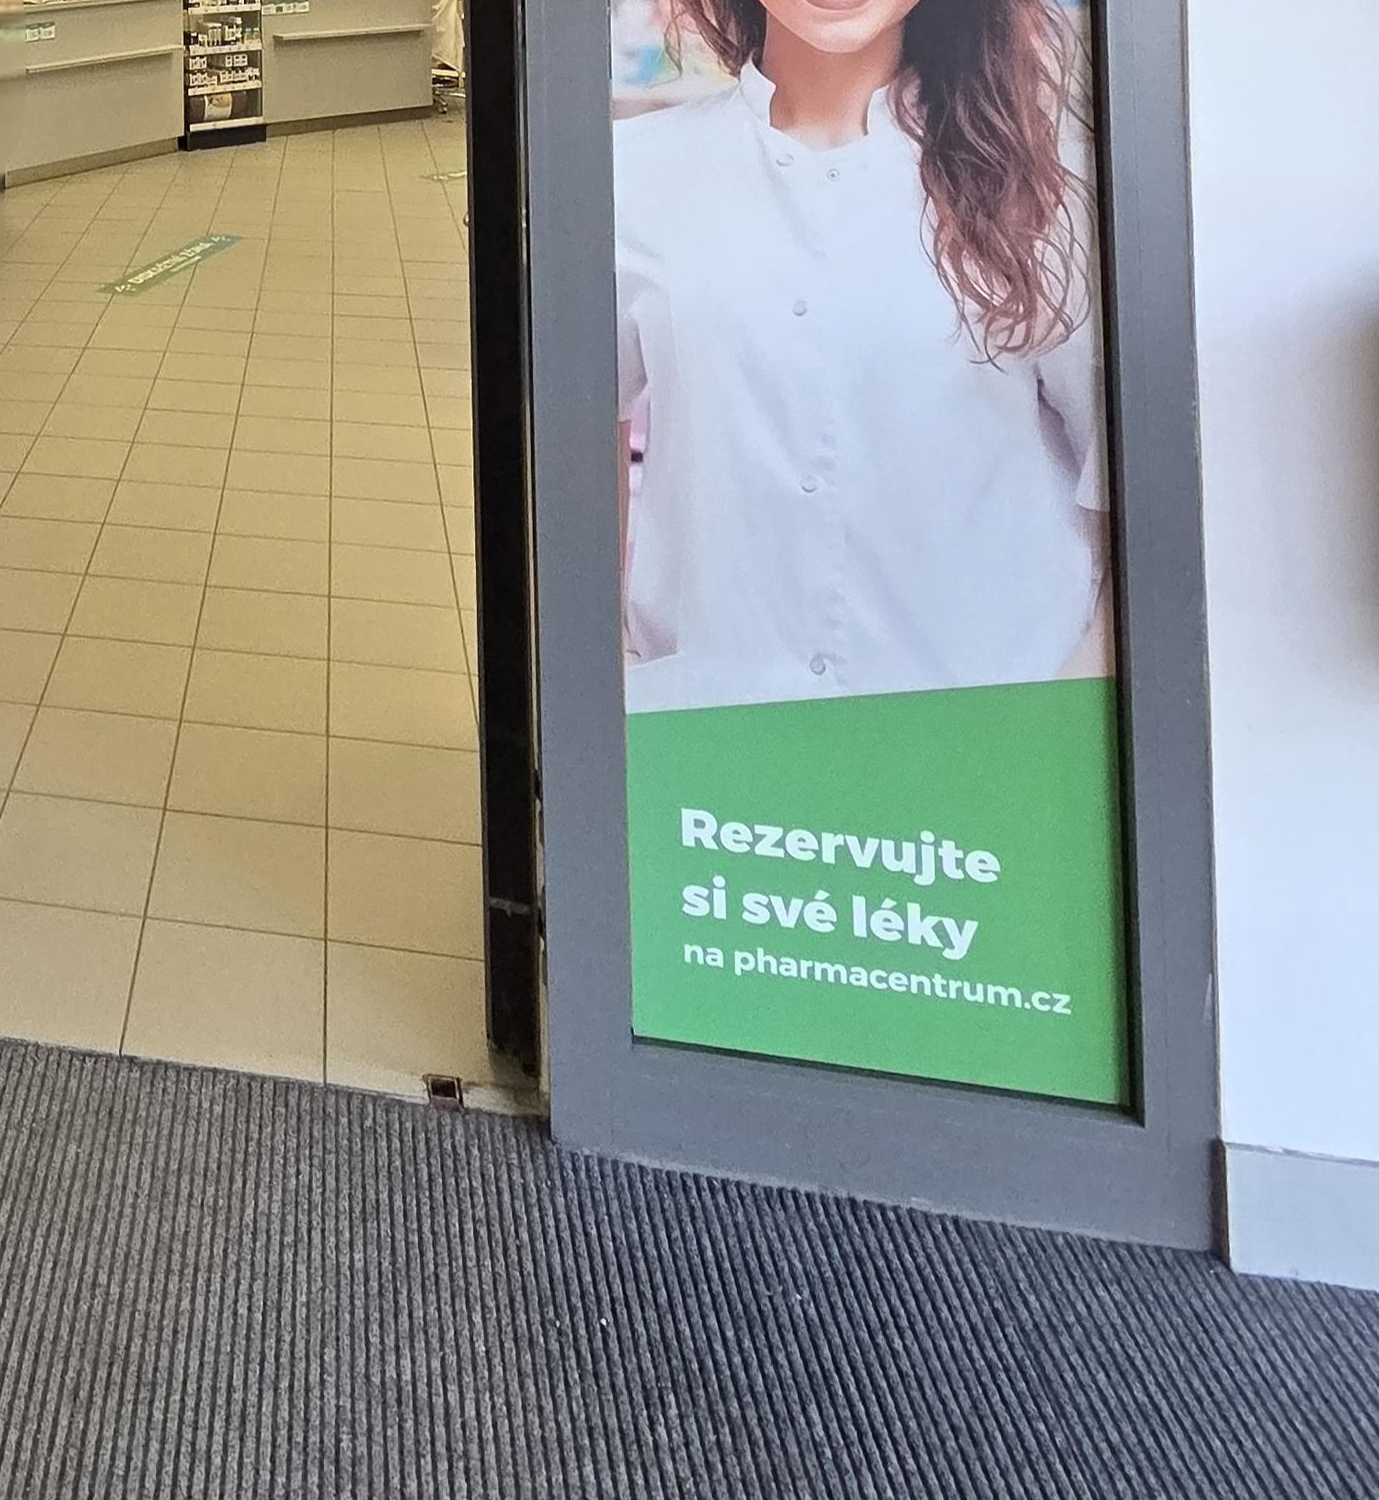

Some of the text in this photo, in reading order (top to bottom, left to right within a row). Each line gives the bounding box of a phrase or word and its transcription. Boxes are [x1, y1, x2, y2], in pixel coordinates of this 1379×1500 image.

[680, 807, 1001, 886] Rezervujte
[681, 875, 978, 960] si své léky
[683, 943, 1072, 1015] na pharmacentrum.cz
